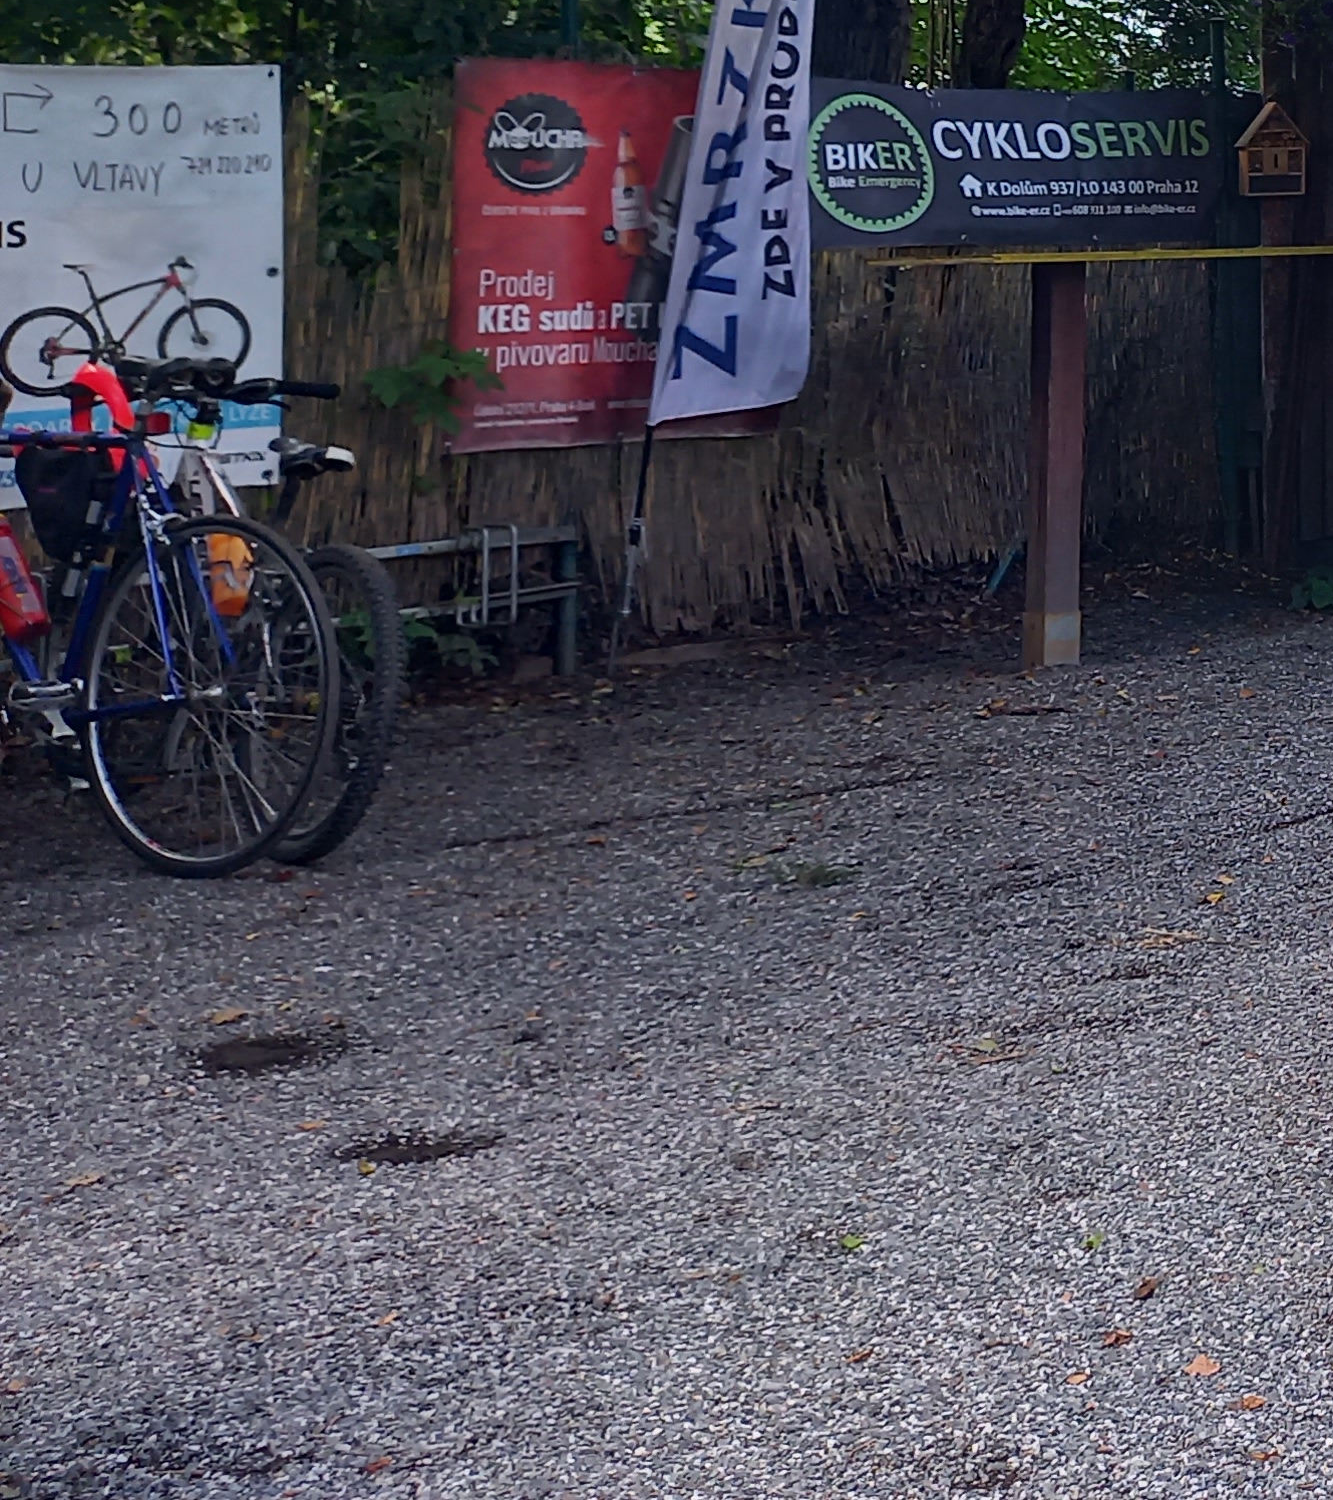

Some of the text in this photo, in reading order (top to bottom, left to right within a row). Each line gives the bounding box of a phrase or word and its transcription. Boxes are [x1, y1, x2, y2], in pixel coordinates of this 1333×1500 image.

[91, 95, 183, 137] 300
[931, 118, 1211, 161] CYKLOSERVIS
[824, 141, 918, 172] BIKER
[21, 161, 44, 194] U
[72, 160, 166, 197] VLTAVY
[763, 157, 794, 195] V
[827, 174, 857, 188] Bike
[986, 179, 1199, 197] K Dolům 937/10 143 00 Praha 12
[760, 208, 797, 301] ZDE
[478, 269, 555, 301] Prodej
[477, 303, 531, 334] KEG
[609, 302, 653, 330] PET
[495, 341, 590, 373] pivovaru
